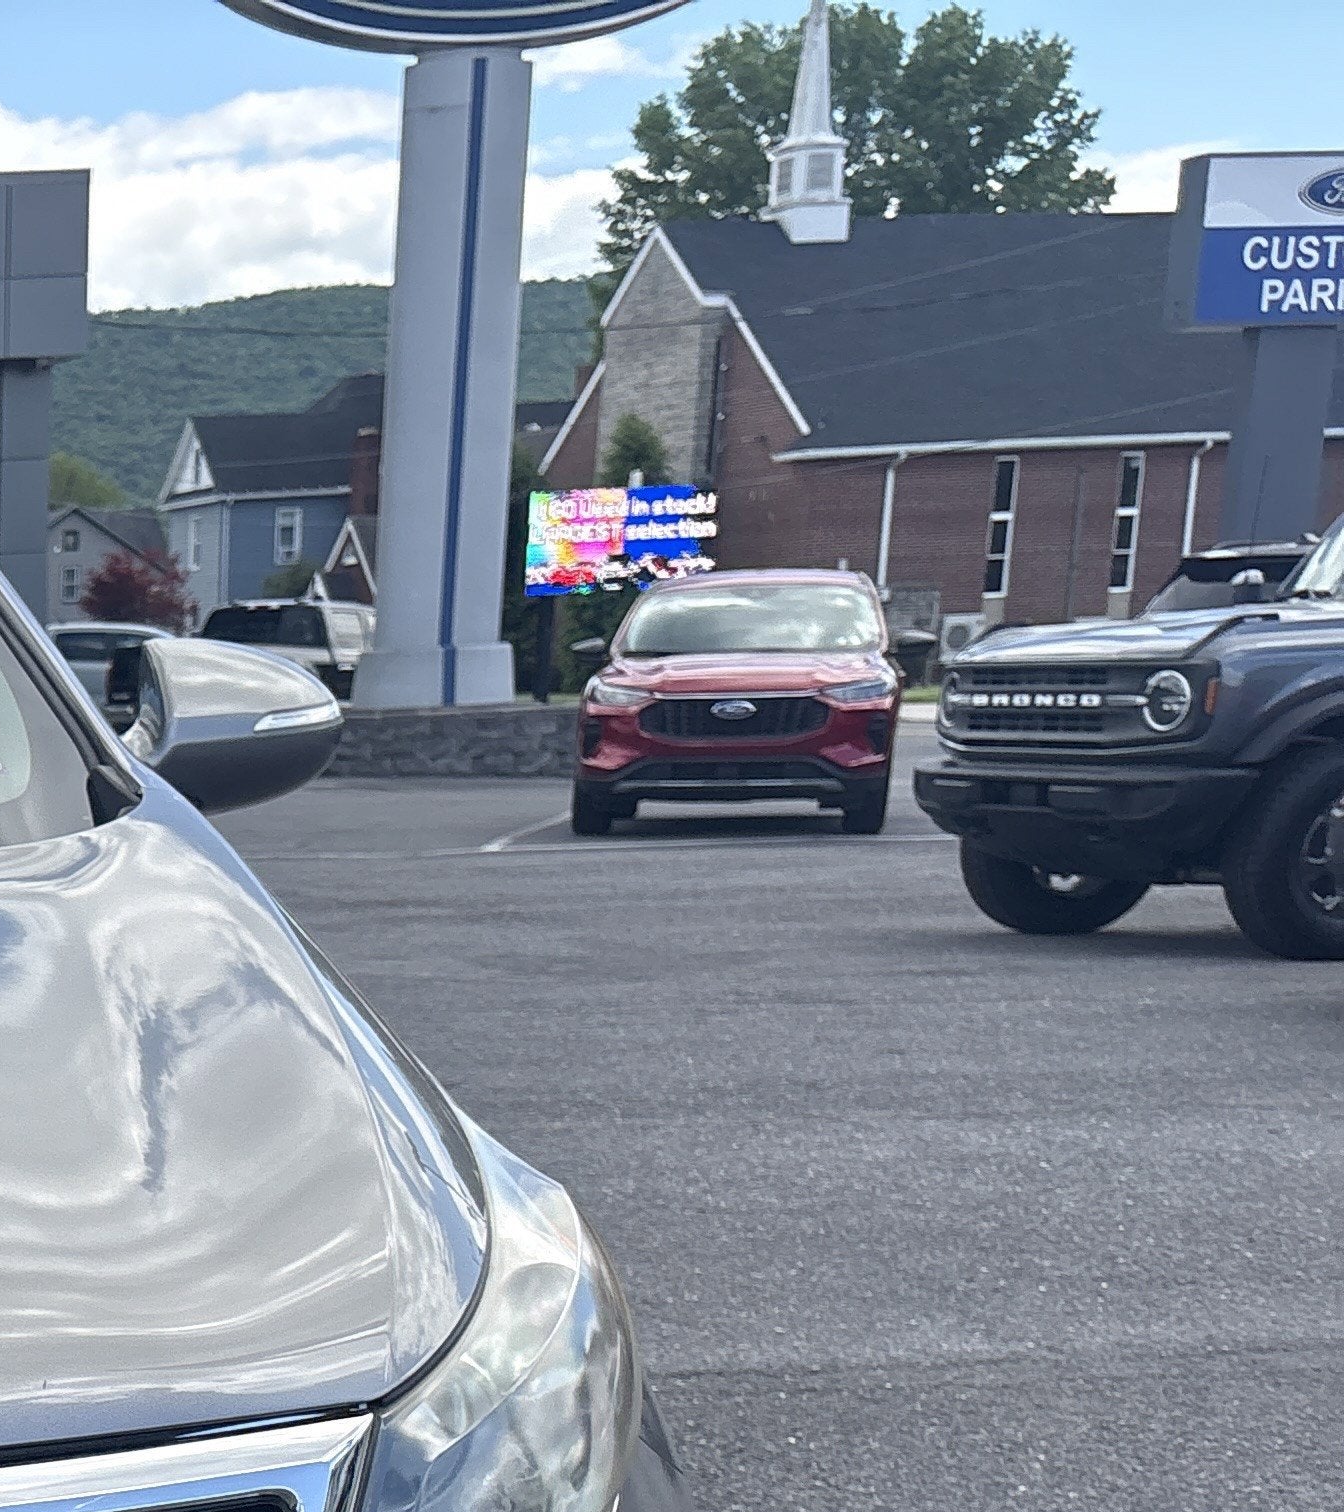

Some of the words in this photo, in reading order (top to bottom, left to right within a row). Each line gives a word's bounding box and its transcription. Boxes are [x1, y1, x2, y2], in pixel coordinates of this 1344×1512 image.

[1242, 235, 1344, 271] CUST
[631, 495, 650, 516] in
[625, 519, 717, 541] selection
[972, 693, 1102, 707] BRONCO
